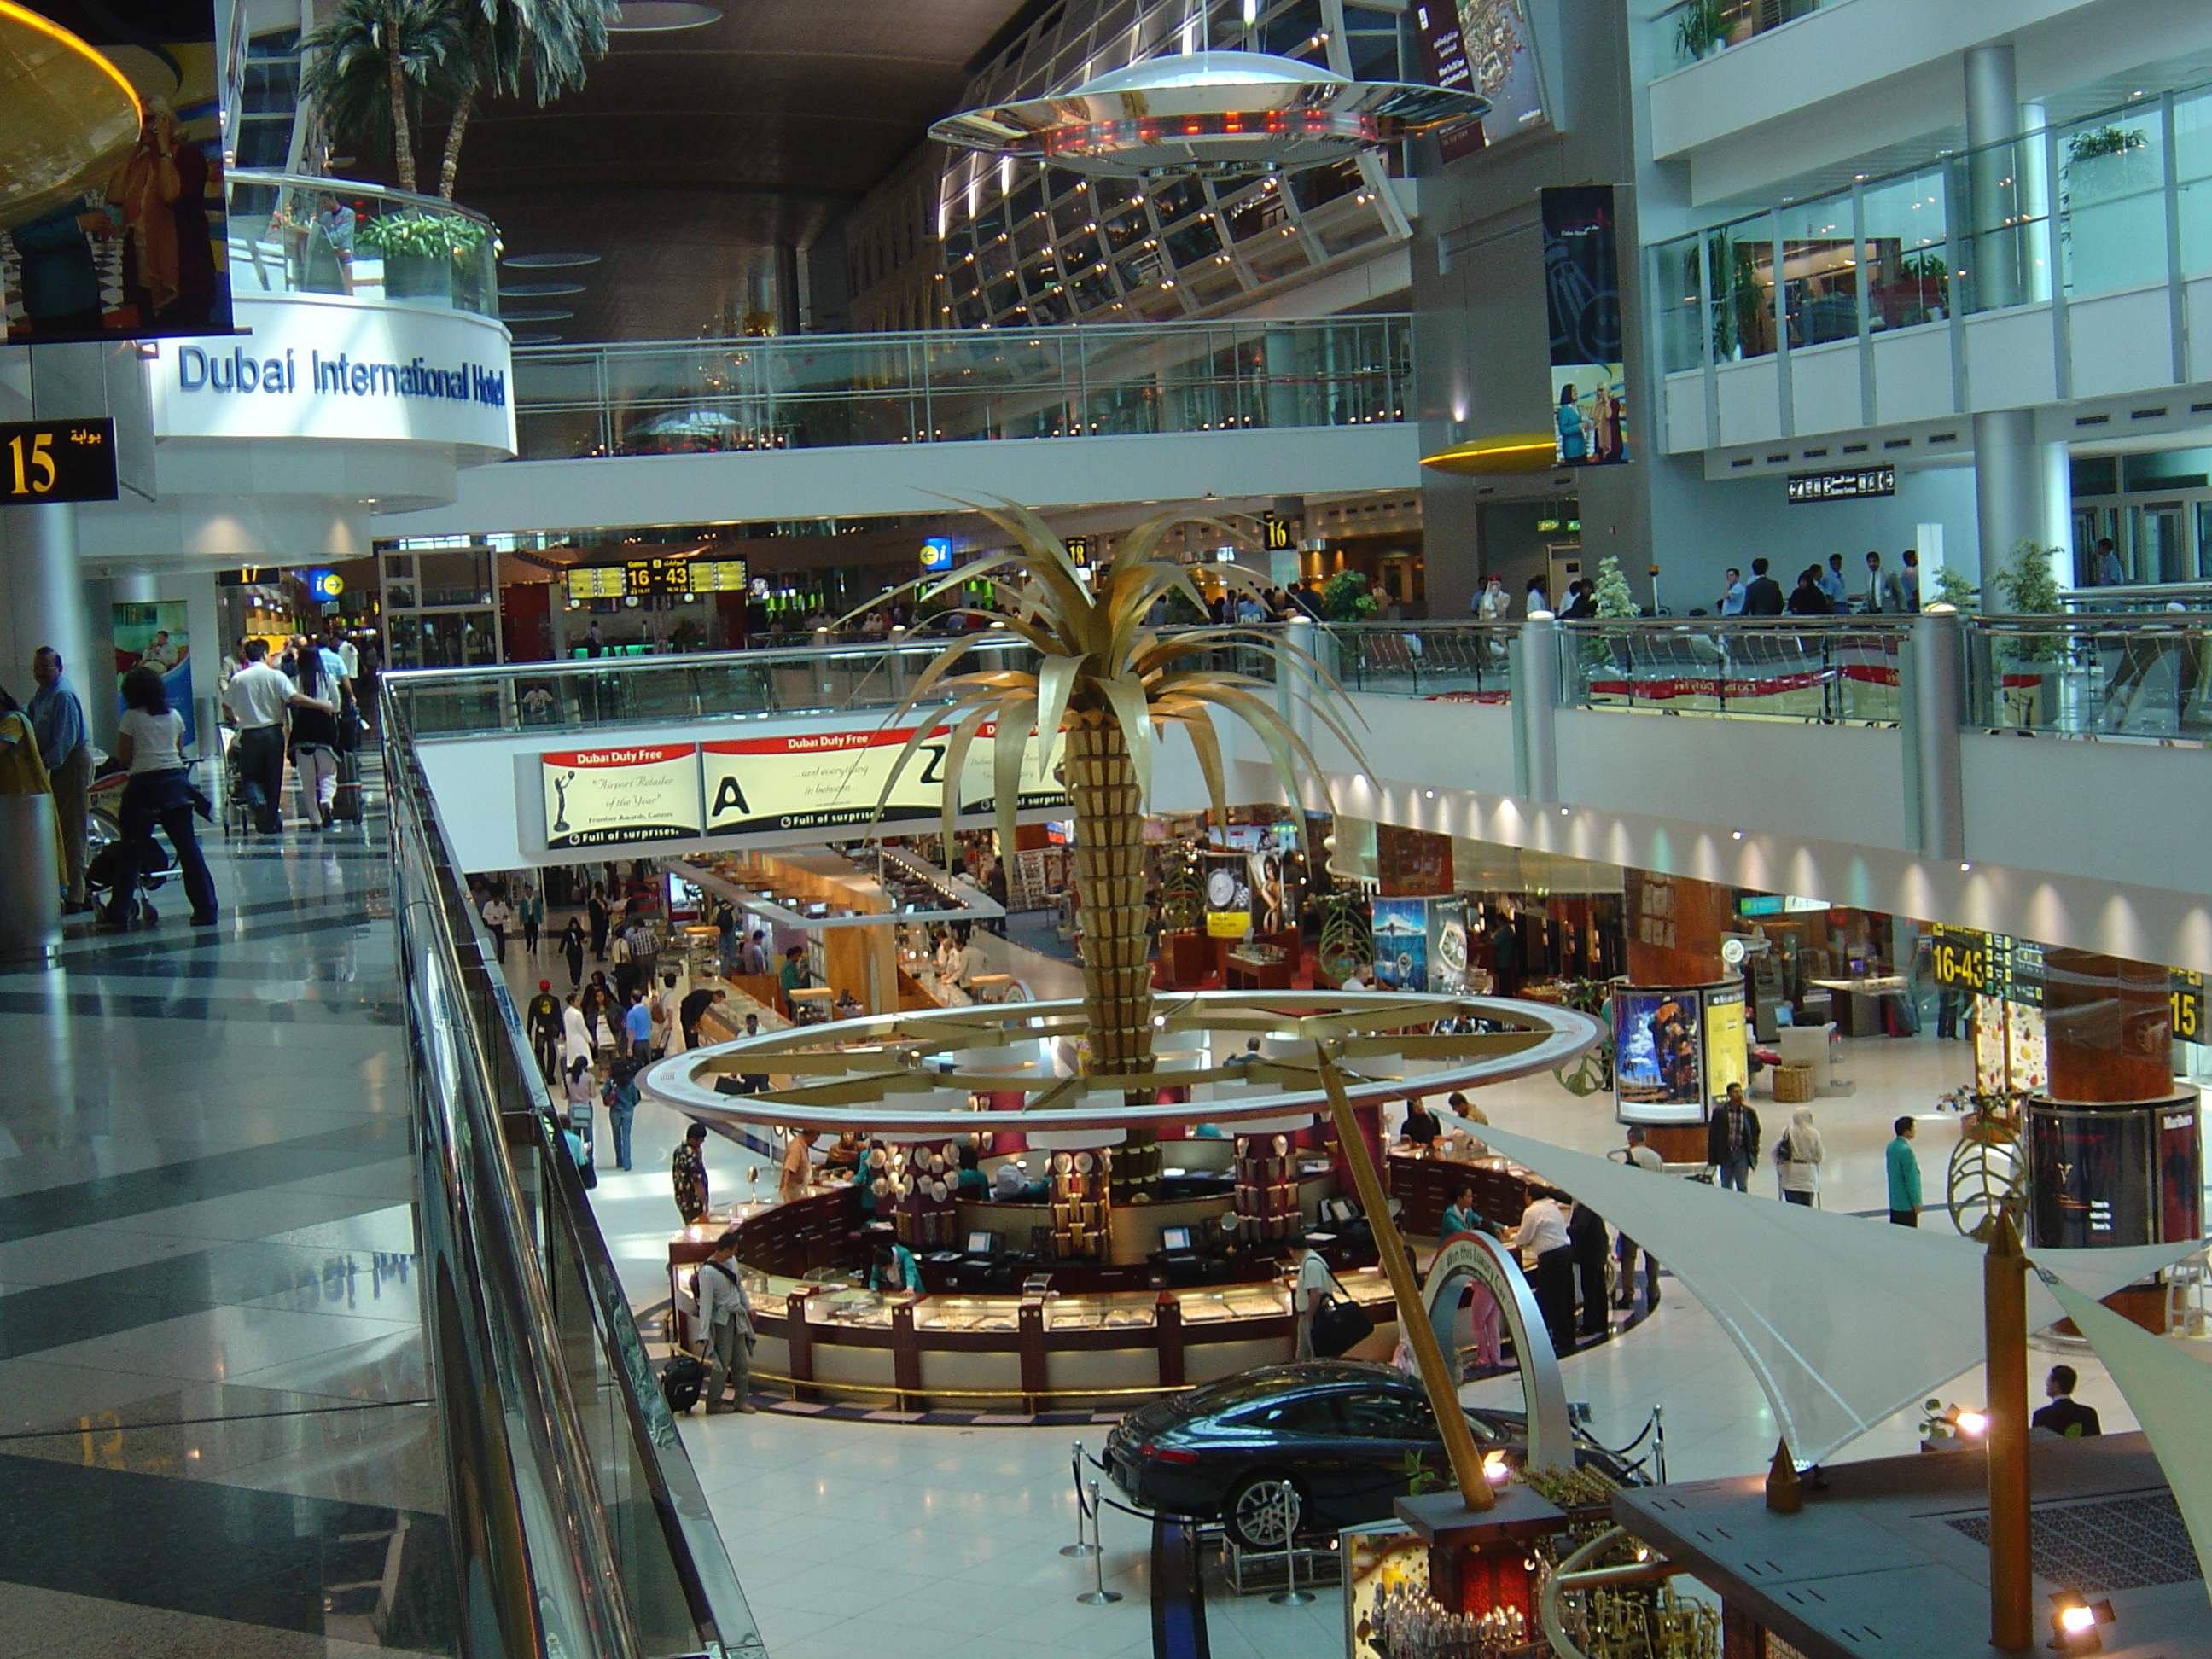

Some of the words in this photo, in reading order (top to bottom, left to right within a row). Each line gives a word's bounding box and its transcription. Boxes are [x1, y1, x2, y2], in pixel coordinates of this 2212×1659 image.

[179, 345, 295, 393] Dubai
[311, 349, 469, 400] International
[472, 364, 505, 406] Hotel
[70, 428, 102, 445] بوابة
[8, 432, 55, 494] 15
[1269, 521, 1286, 547] 16
[1069, 544, 1085, 567] 18
[628, 569, 649, 586] 16
[666, 568, 687, 584] 43
[788, 738, 819, 749] Dubai
[820, 736, 845, 748] Duty
[846, 734, 869, 744] Free
[577, 752, 609, 764] Dubai
[611, 751, 637, 763] Duty
[639, 750, 663, 760] Free
[919, 743, 947, 783] Z
[821, 763, 870, 778] everything
[637, 775, 674, 788] Retailer
[616, 795, 631, 806] the
[712, 776, 751, 817] A
[793, 815, 814, 826] Full
[818, 813, 829, 824] of
[582, 831, 604, 843] Full
[608, 830, 619, 841] of
[623, 827, 680, 840] surprises.
[1933, 944, 1983, 988] 16-43
[2169, 992, 2196, 1036] 15
[1446, 1249, 1459, 1268] Win
[1460, 1244, 1473, 1261] this
[1473, 1246, 1495, 1282] Luxury
[1494, 1274, 1506, 1301] Car
